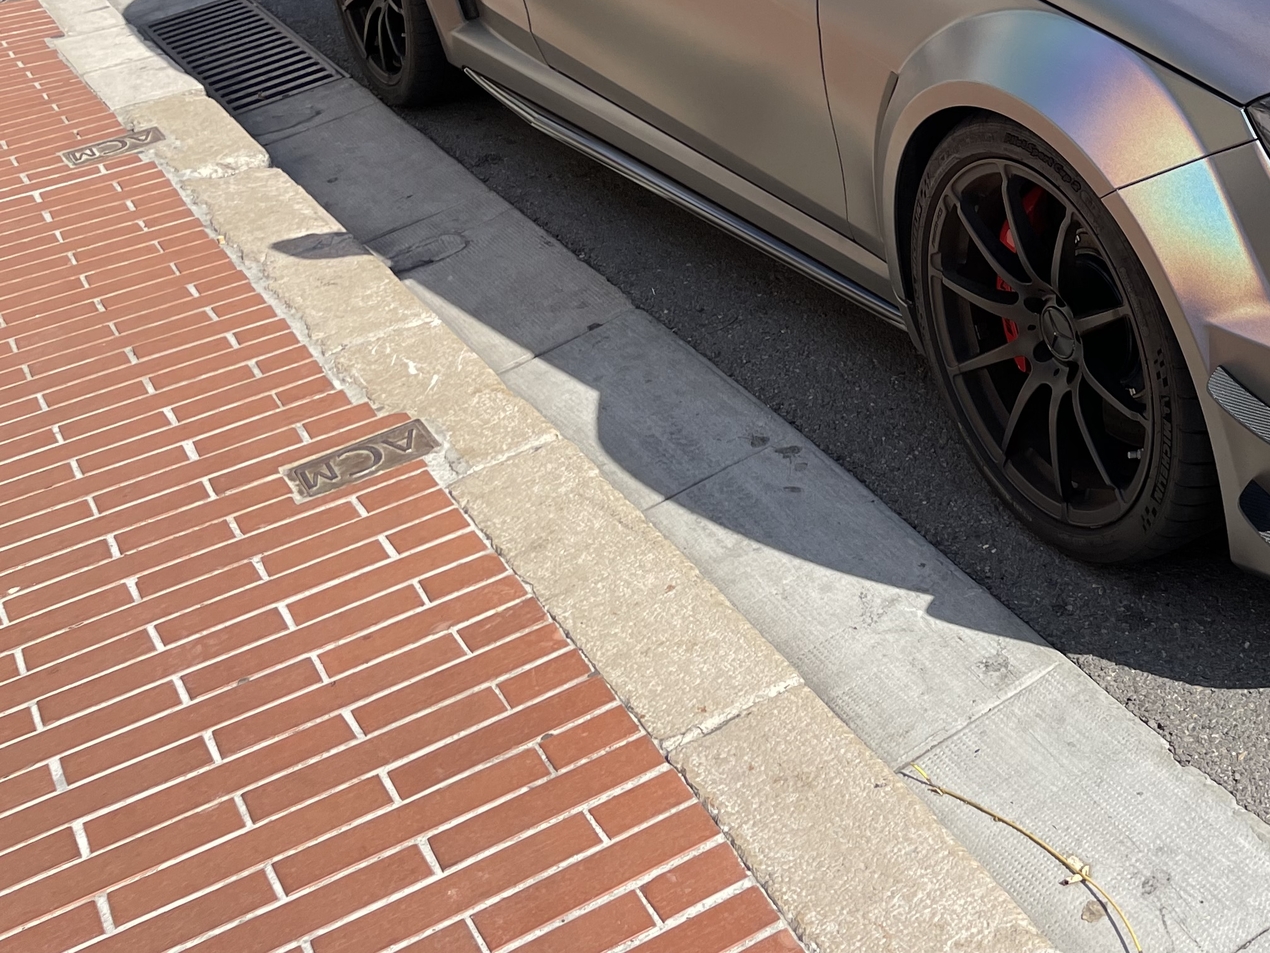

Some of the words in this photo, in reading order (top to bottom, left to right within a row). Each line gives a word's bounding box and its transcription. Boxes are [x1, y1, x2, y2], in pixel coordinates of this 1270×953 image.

[1053, 162, 1072, 184] Cup
[1071, 179, 1081, 193] 2
[1151, 417, 1173, 506] MICHELIN
